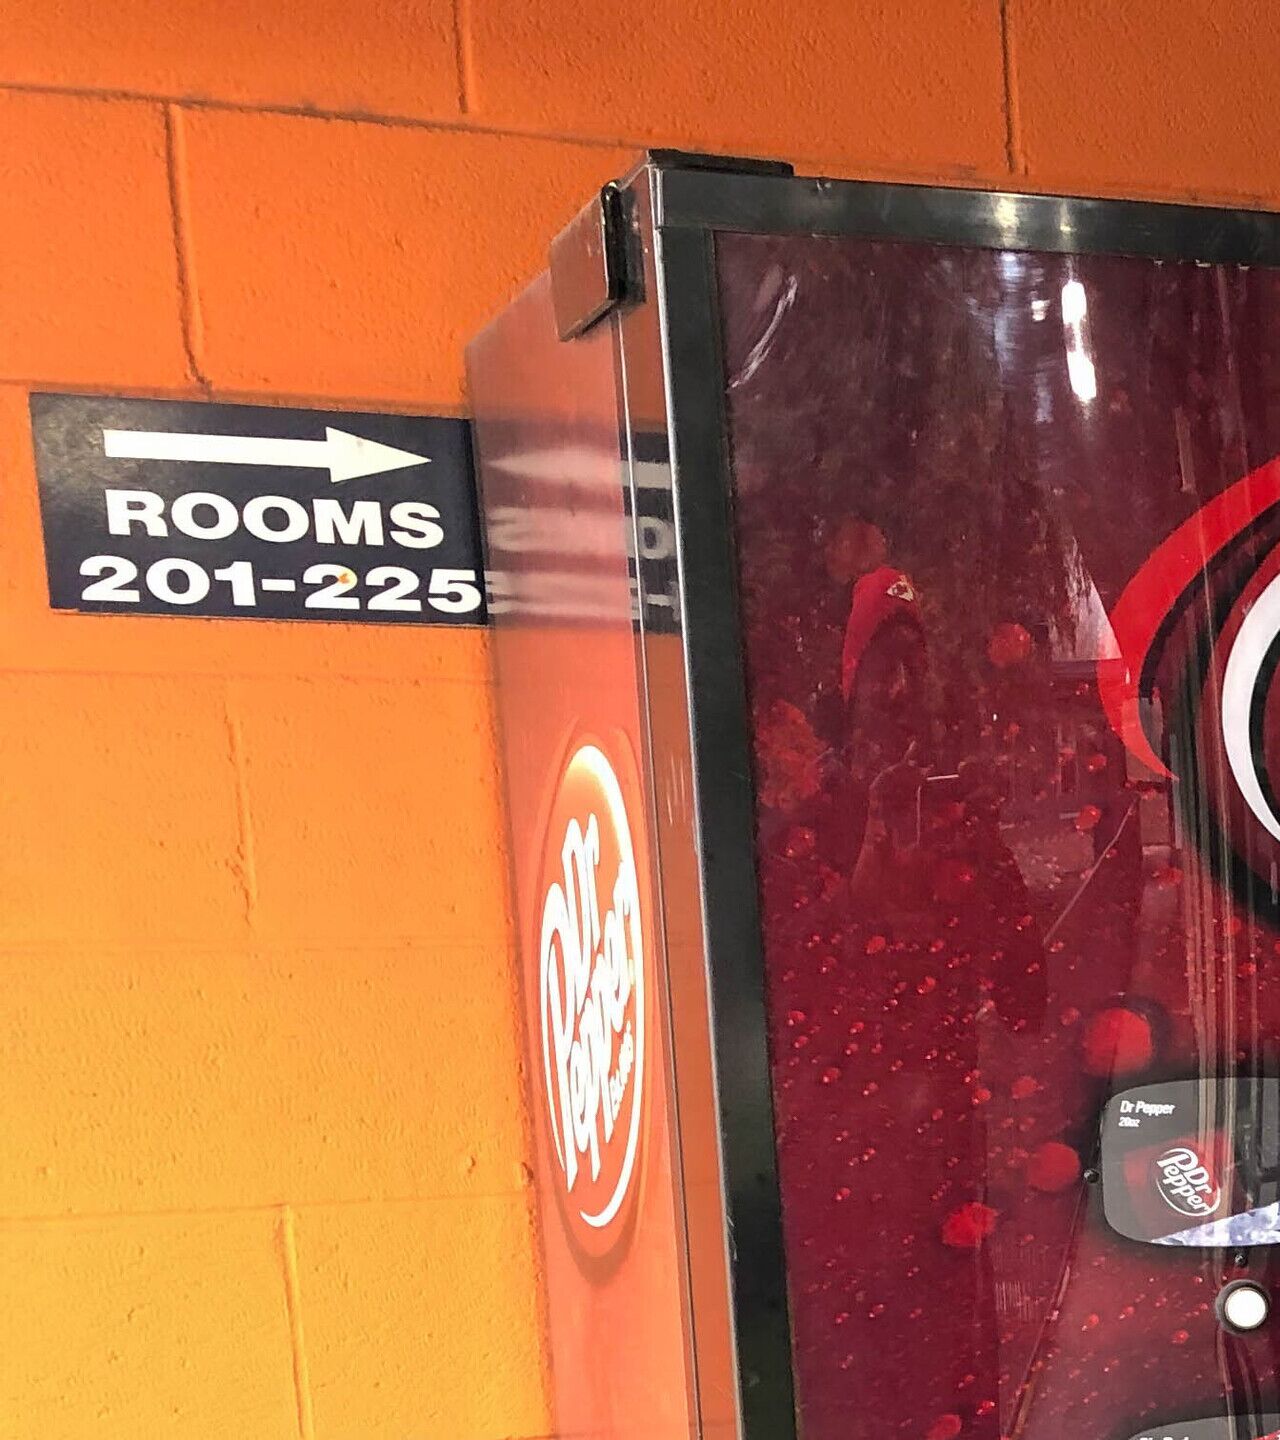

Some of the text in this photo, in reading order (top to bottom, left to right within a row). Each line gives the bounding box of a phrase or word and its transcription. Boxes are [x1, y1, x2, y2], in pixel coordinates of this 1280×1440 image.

[106, 488, 445, 549] ROOMS
[78, 555, 484, 616] 201-225
[562, 812, 601, 1014] Dr
[540, 859, 634, 1194] Pepper
[1118, 1116, 1140, 1129] 20oz
[1119, 1100, 1176, 1117] Dr Pepper
[1156, 1147, 1210, 1214] Pepper
[1183, 1161, 1212, 1195] Dr
